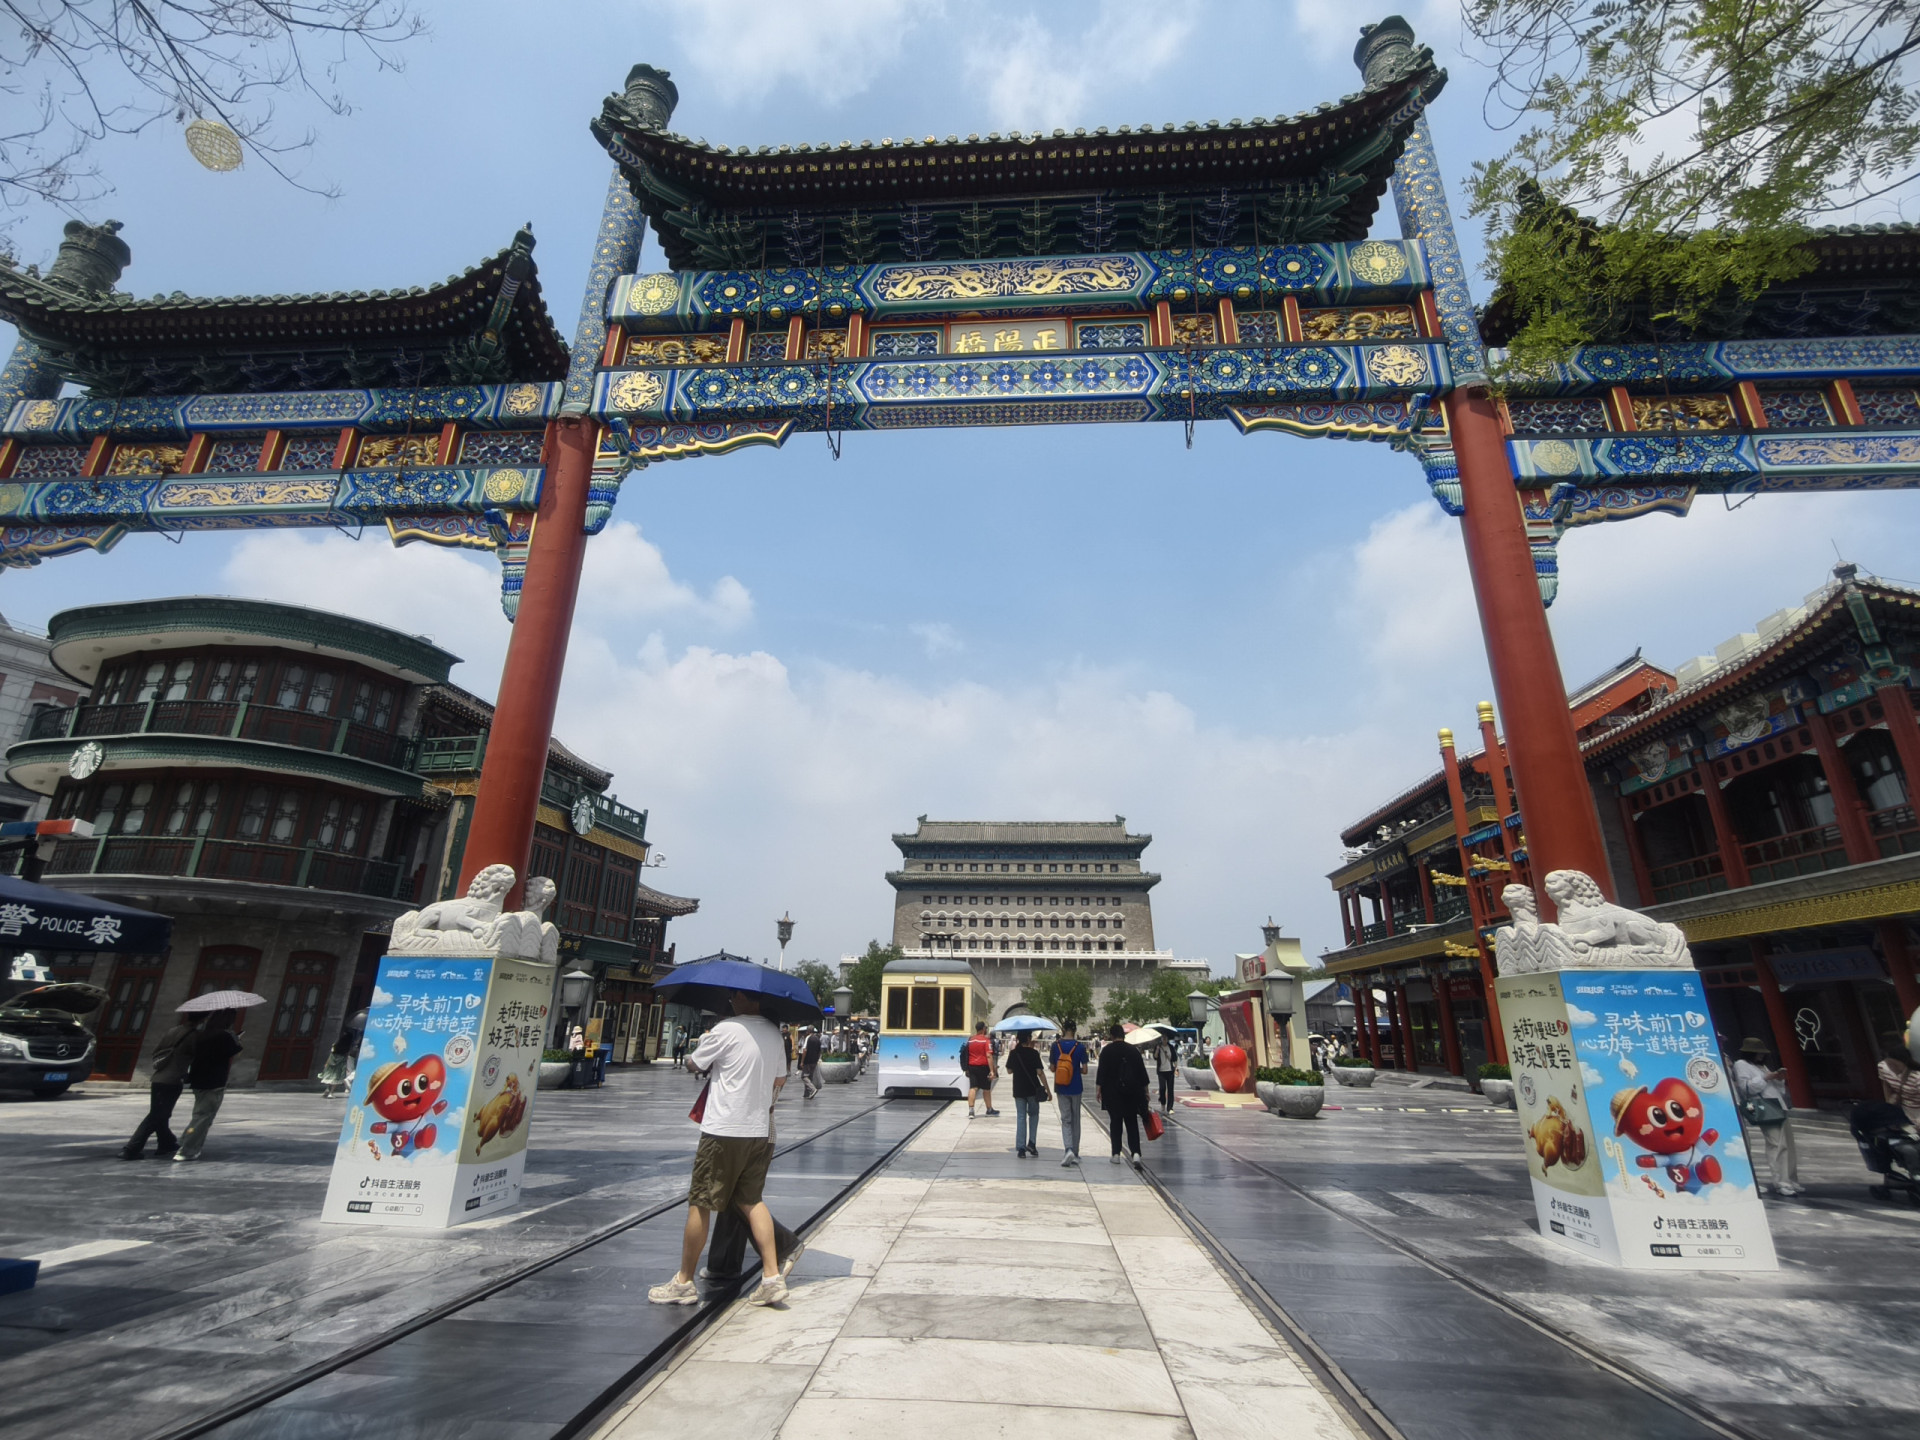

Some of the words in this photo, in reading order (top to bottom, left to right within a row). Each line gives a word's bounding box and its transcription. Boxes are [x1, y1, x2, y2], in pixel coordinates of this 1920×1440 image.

[0, 903, 39, 936] 警
[39, 916, 86, 934] POLICE
[84, 915, 122, 944] 察
[396, 993, 463, 1015] 寻味前门
[497, 1000, 539, 1023] 老街慢逛
[371, 1013, 477, 1036] 心动每一道特色菜
[1513, 1017, 1559, 1042] 老街慢逛
[1604, 1010, 1685, 1036] 寻味前门
[487, 1023, 541, 1049] 好菜慢尝
[1582, 1033, 1717, 1058] 心动每一道特色菜
[1512, 1042, 1571, 1069] 好菜慢尝
[371, 1179, 421, 1190] 抖音生活服务
[1666, 1218, 1729, 1230] 抖音生活服务
